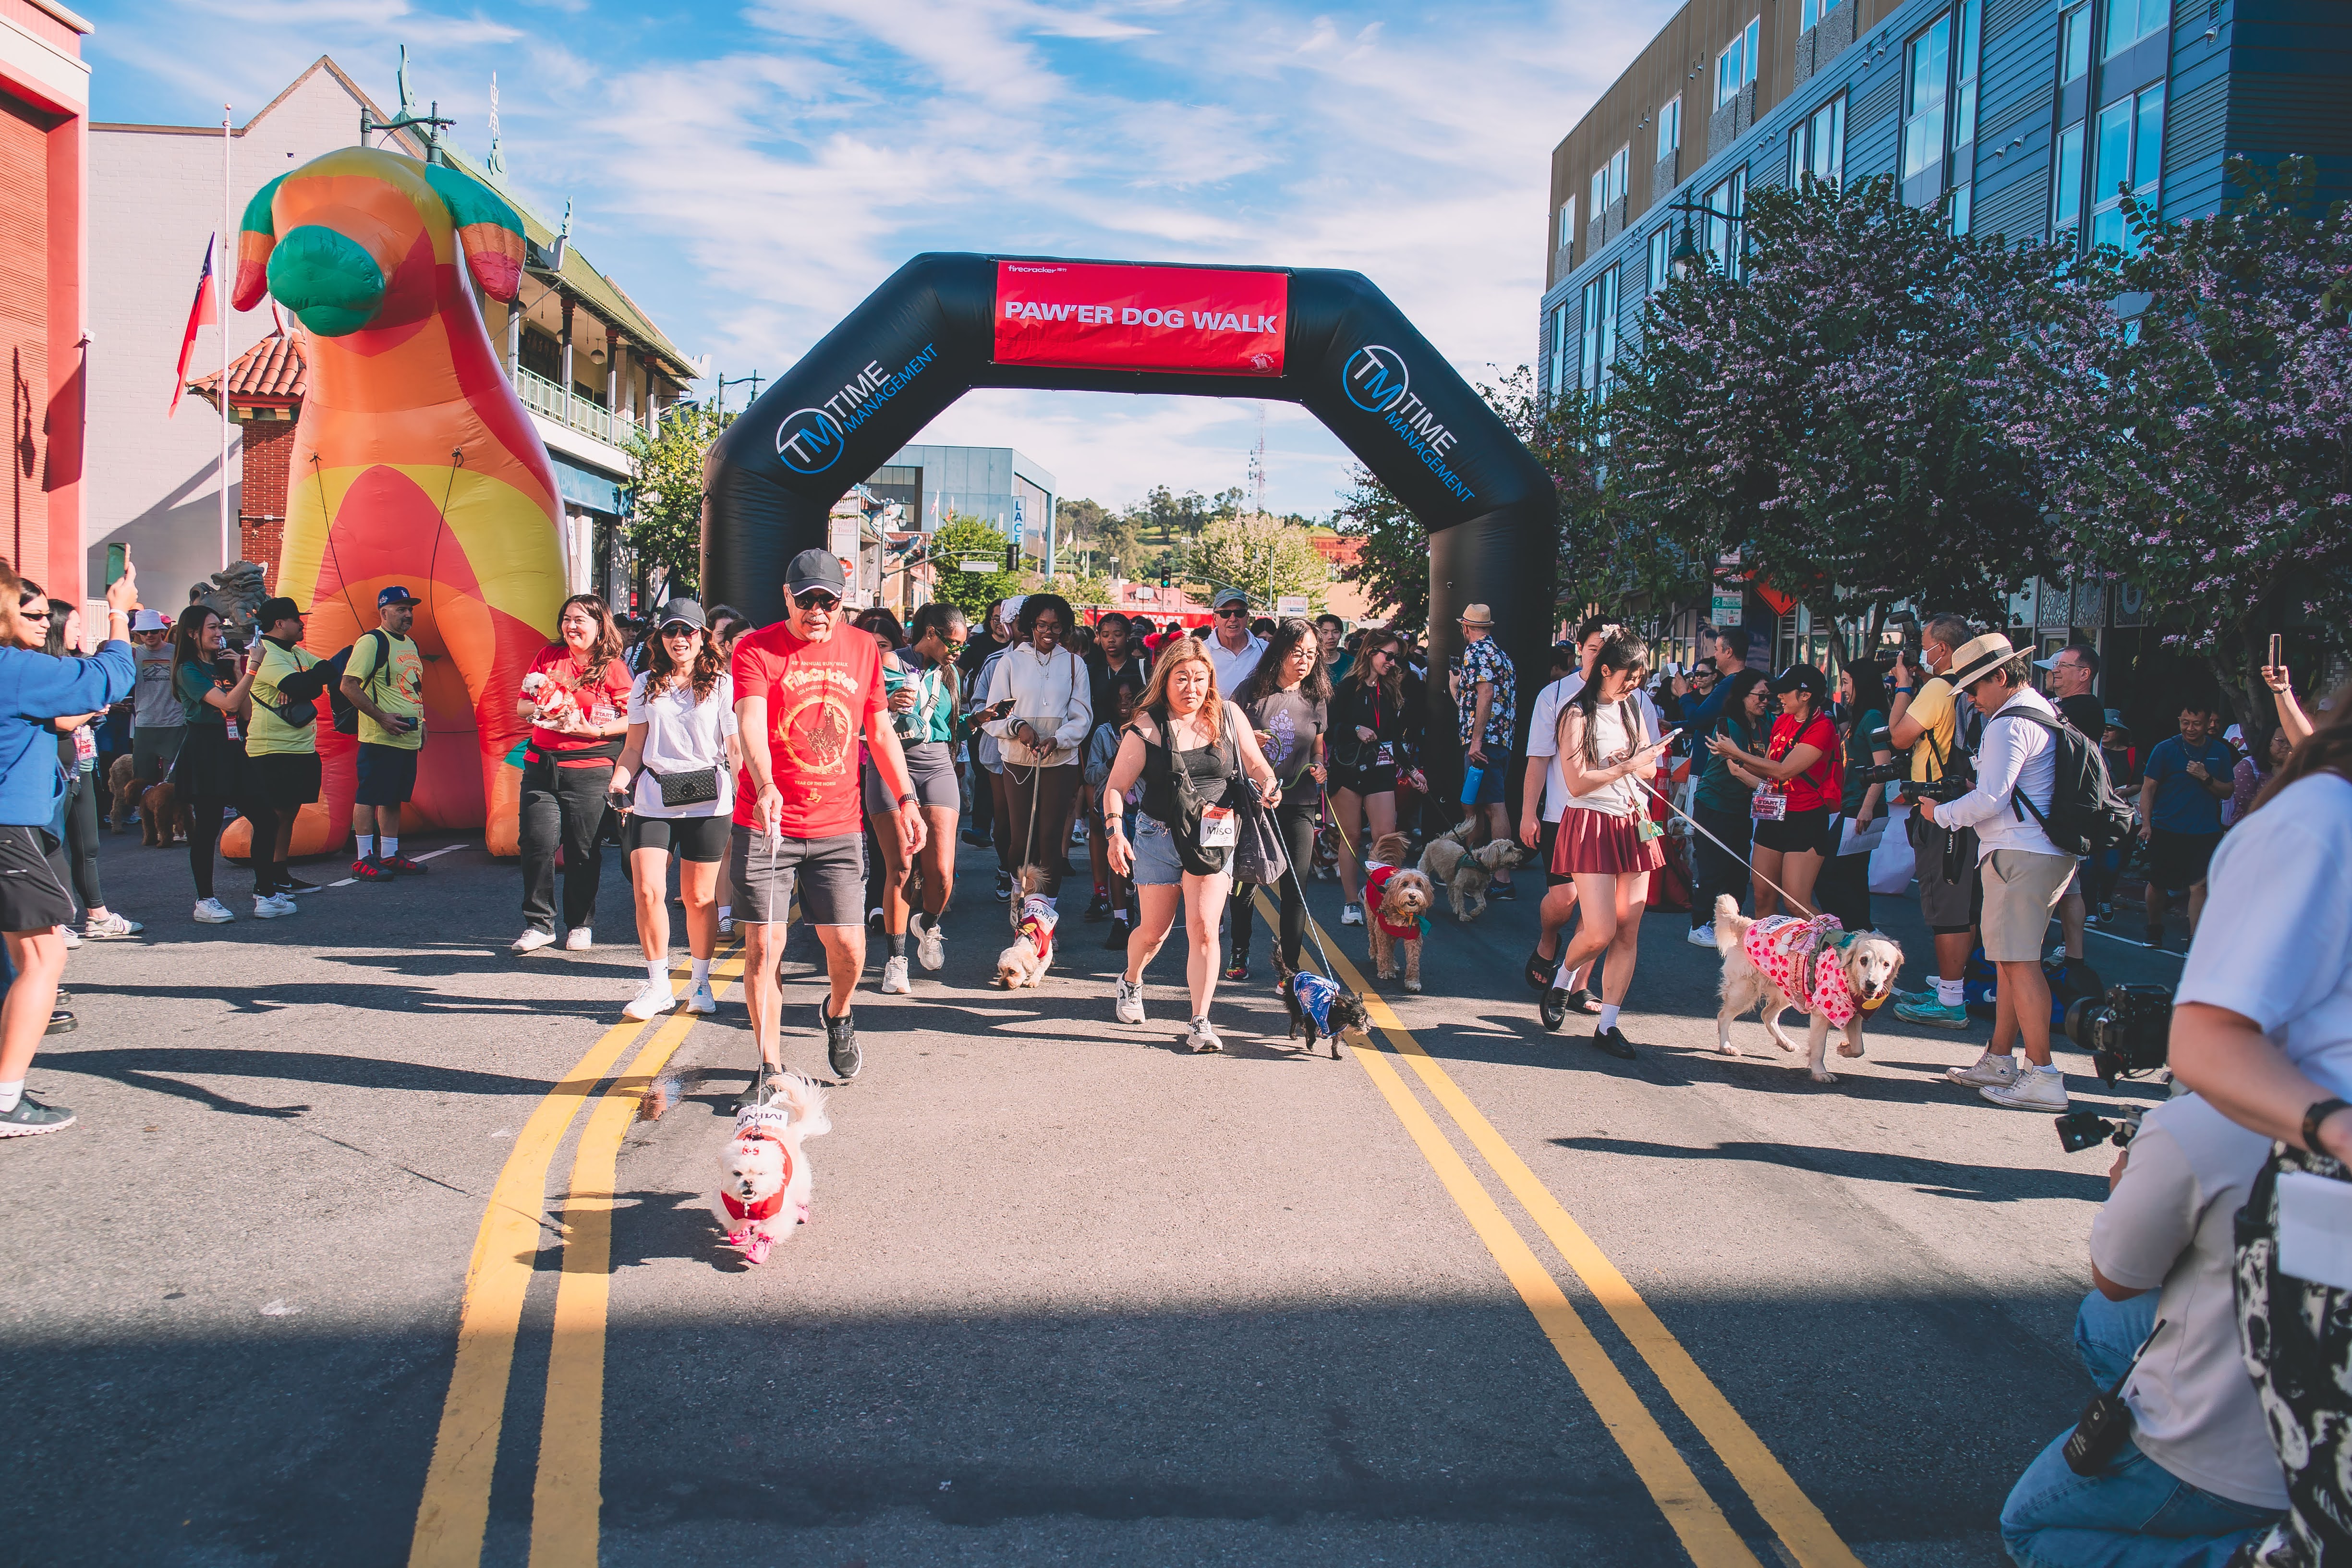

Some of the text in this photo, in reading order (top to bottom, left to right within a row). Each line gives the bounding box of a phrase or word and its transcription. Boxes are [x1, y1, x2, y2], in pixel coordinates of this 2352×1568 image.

[1008, 265, 1057, 273] firecracker
[1005, 301, 1278, 334] PAW'ER DOG WALK
[824, 360, 891, 418] TIME
[843, 343, 937, 433] MANAGEMENT
[1354, 348, 1403, 412] TM
[778, 414, 844, 463] TM
[1400, 392, 1457, 457] TIME
[1385, 411, 1475, 502] MANAGEMENT
[1207, 826, 1232, 835] MISO
[1778, 799, 1786, 821] 2026
